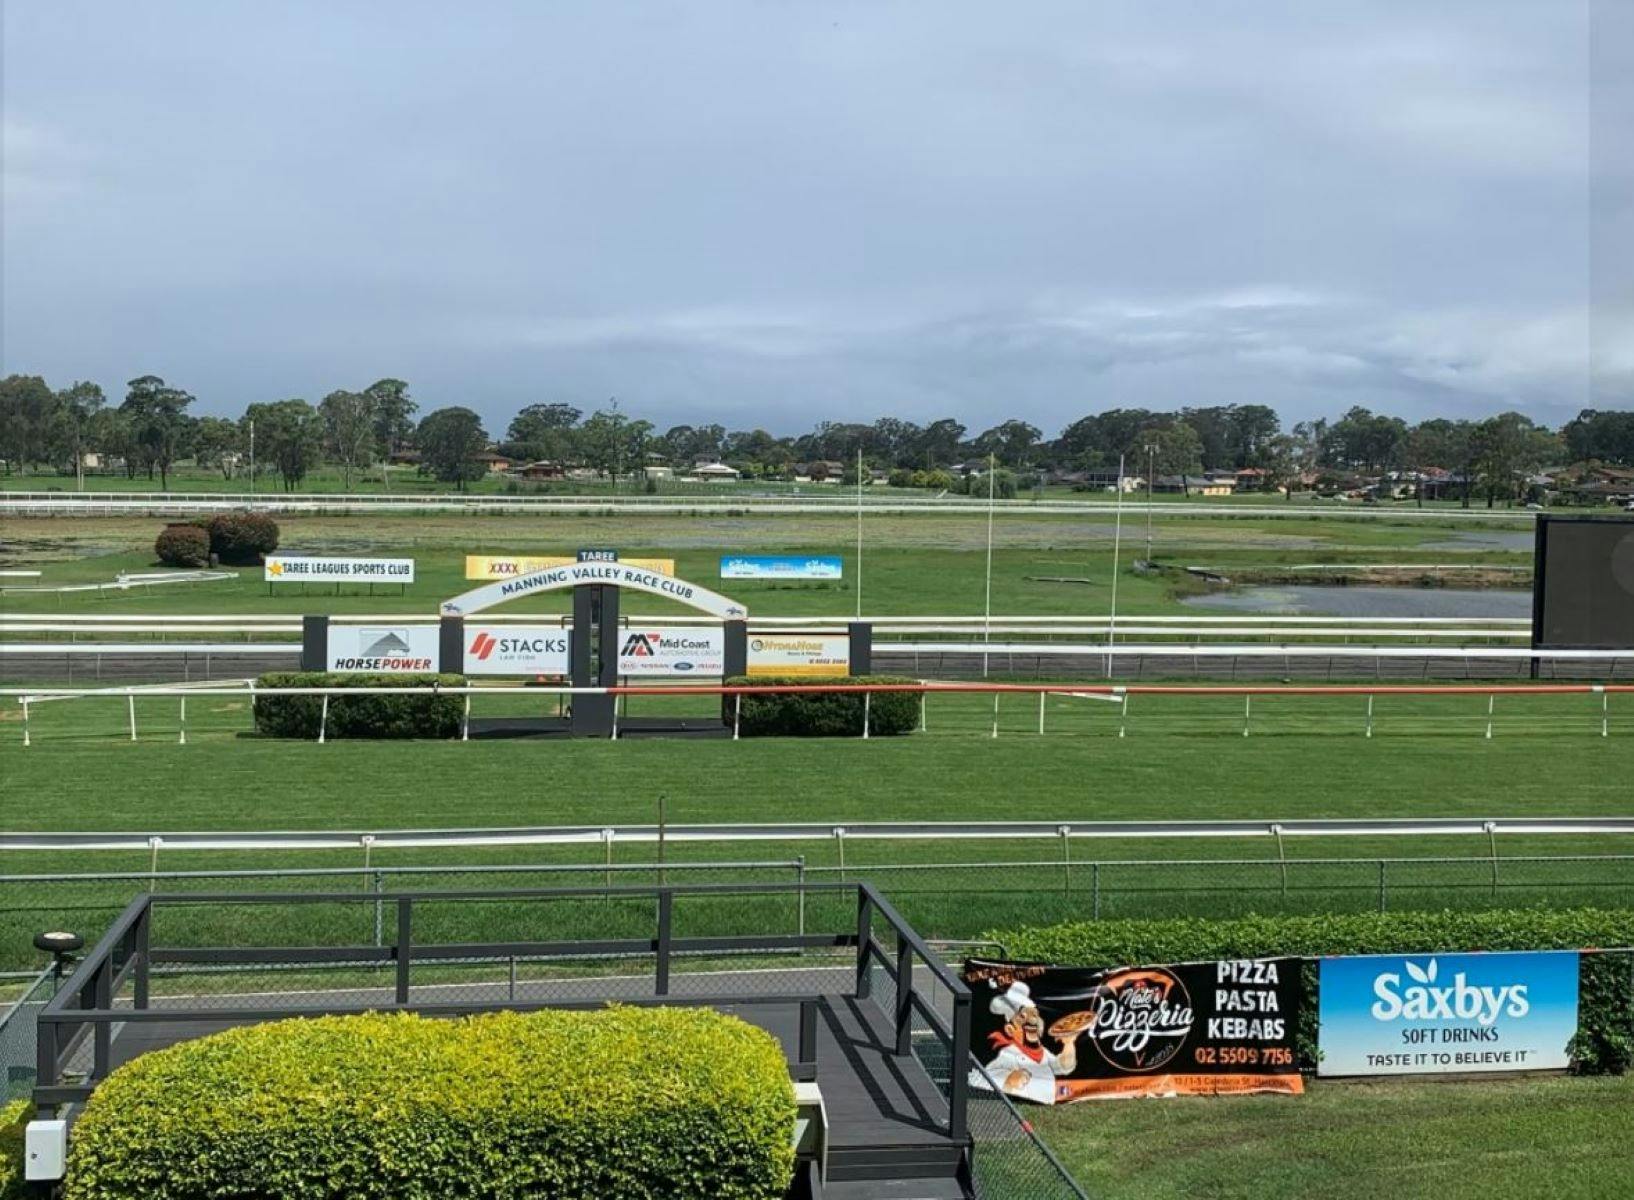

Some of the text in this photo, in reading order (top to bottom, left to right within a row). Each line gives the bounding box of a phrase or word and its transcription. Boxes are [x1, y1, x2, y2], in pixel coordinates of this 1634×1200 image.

[581, 551, 615, 561] TAREE
[283, 562, 411, 576] TAREE LEAGUES SPORTS CLUB
[489, 562, 520, 574] XXXX
[501, 570, 568, 596] MANNING
[572, 567, 621, 579] VALLEY
[624, 570, 658, 588] RACE
[661, 580, 694, 599] CLUB
[499, 638, 567, 653] STACKS
[659, 638, 711, 650] Mid Coast
[334, 657, 433, 671] HORSEPOWER
[1216, 960, 1280, 985] PIZZA
[1215, 989, 1280, 1012] PASTA
[1370, 972, 1530, 1026] Saxbys
[1089, 996, 1196, 1052] Pizzeria
[1207, 1017, 1286, 1040] KEBABS
[1401, 1026, 1499, 1045] SOFT DRINKS
[1194, 1048, 1217, 1065] 02
[1219, 1048, 1259, 1065] 5509
[1261, 1048, 1293, 1065] 7756
[1366, 1050, 1528, 1067] TASTE IT TO BELIEVE IT
